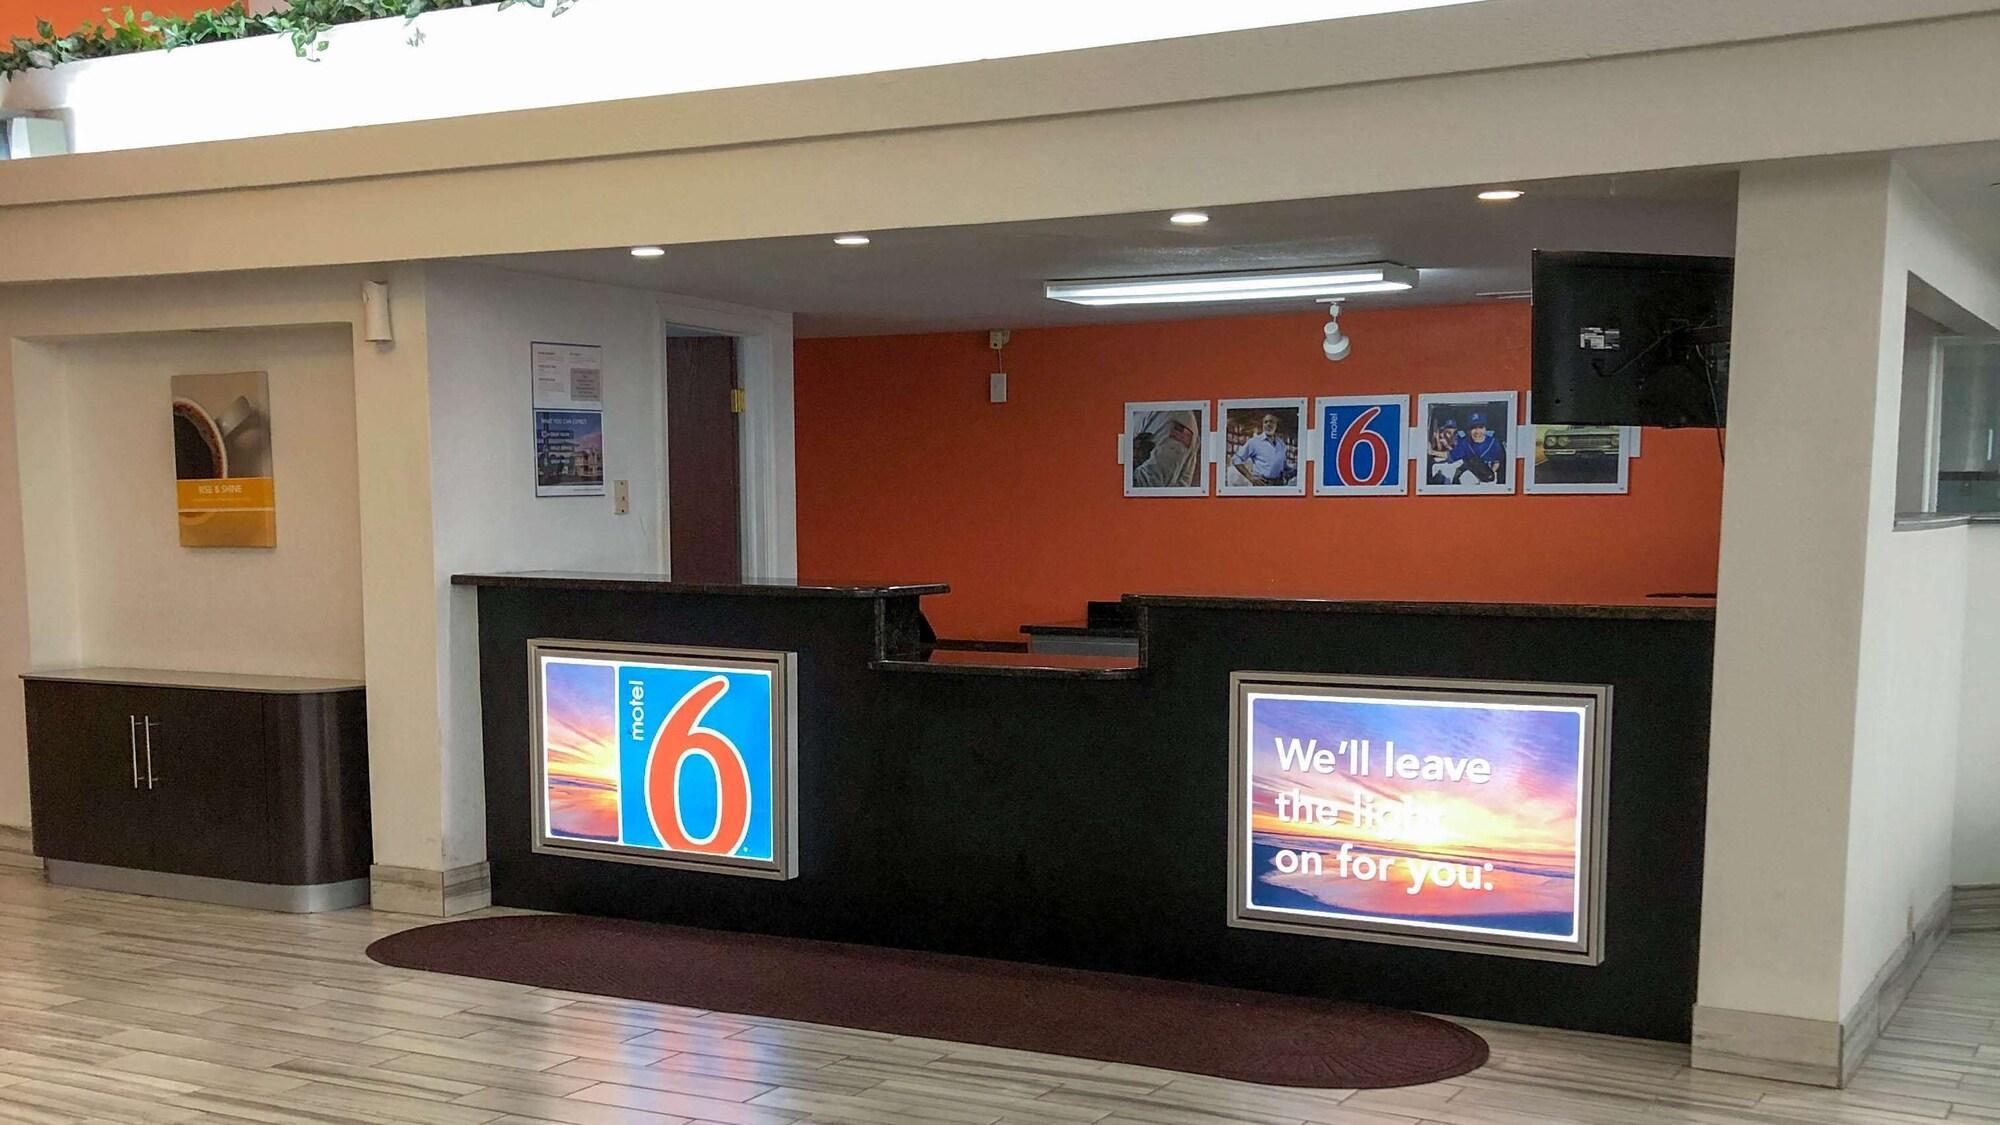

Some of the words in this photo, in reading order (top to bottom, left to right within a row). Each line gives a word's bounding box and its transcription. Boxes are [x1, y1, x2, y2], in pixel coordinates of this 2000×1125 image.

[1329, 413, 1338, 439] motel
[1336, 406, 1390, 486] 6
[628, 679, 645, 742] motel
[644, 674, 752, 856] 6
[1275, 737, 1369, 776] We'll
[1385, 741, 1491, 784] leave
[1275, 788, 1338, 826] the
[1353, 789, 1442, 841] ligh
[1275, 848, 1322, 876] on
[1336, 843, 1395, 881] for
